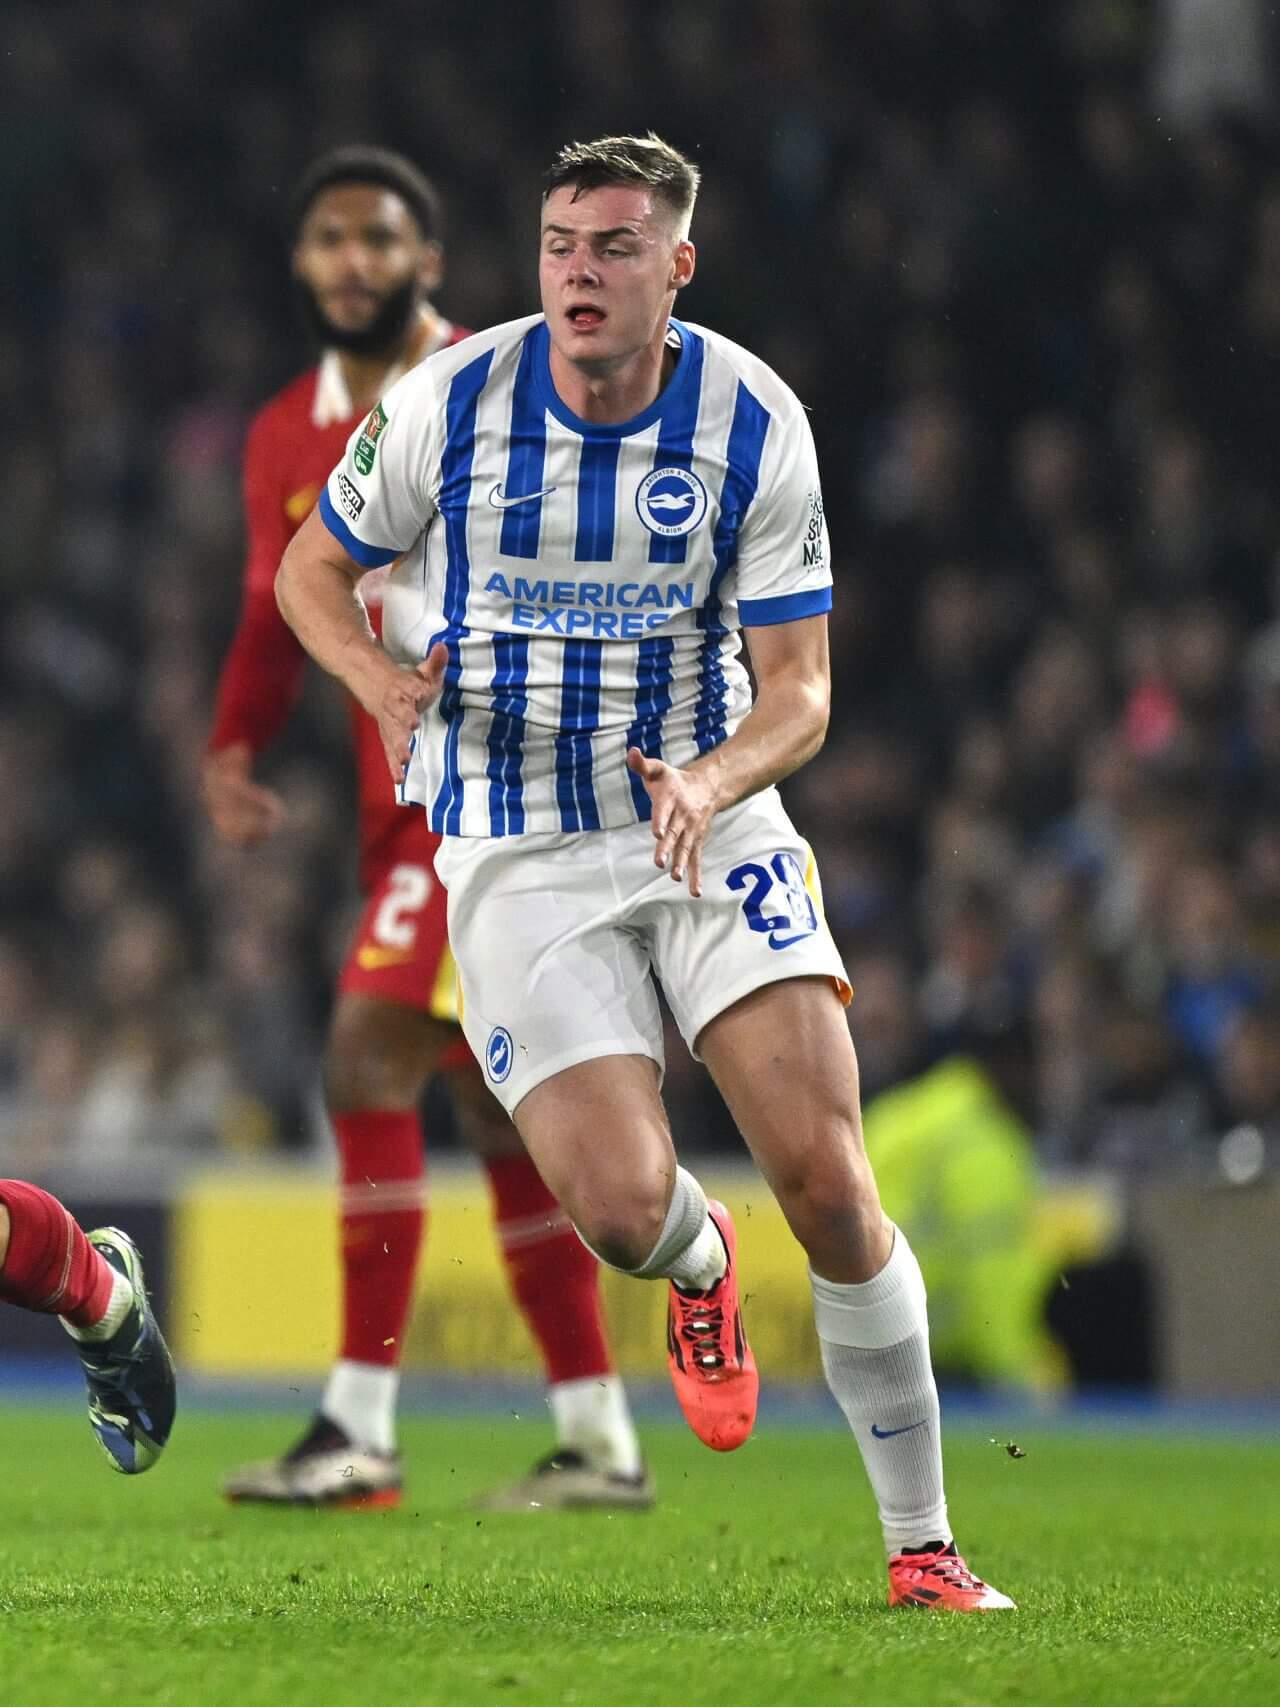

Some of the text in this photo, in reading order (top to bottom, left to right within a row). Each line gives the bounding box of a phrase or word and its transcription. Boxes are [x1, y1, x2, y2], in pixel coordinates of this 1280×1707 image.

[657, 526, 683, 534] ALBION
[484, 572, 694, 608] AMERICAN
[511, 603, 671, 639] EXPRES
[373, 862, 432, 949] 2
